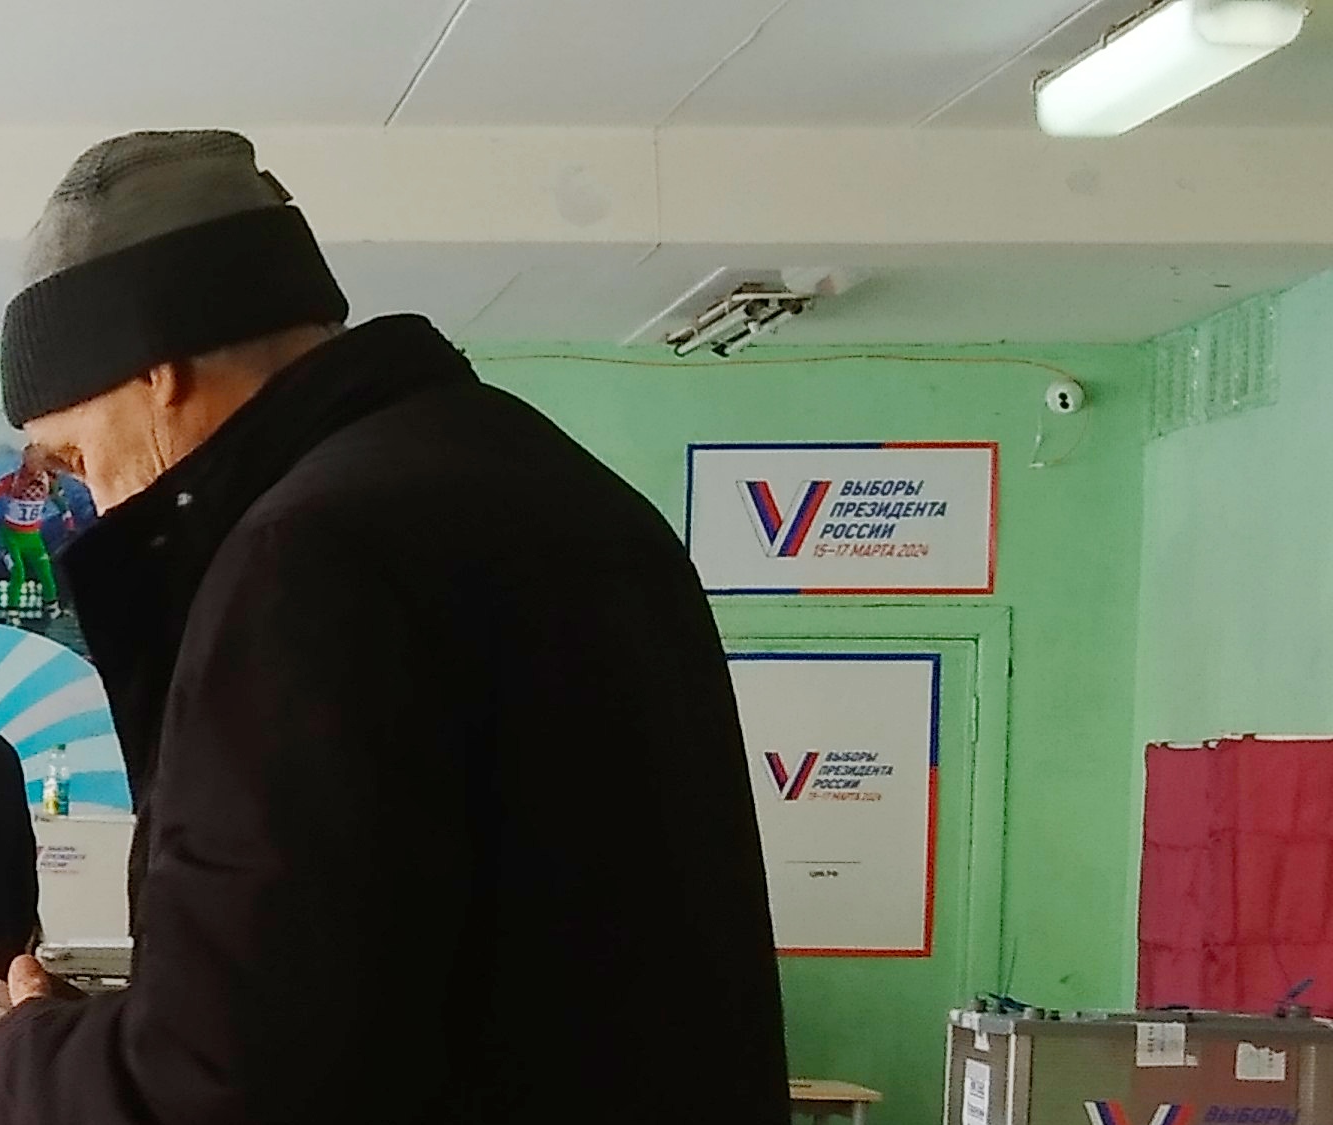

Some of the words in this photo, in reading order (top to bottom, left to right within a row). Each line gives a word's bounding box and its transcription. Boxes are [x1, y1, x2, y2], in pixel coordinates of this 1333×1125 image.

[840, 480, 924, 496] ВЫБОРЫ
[829, 502, 947, 519] ПРЕЗИДЕНТА
[819, 523, 896, 539] РОССИИ
[850, 544, 894, 557] МАРТА
[897, 544, 929, 557] 2024
[818, 765, 893, 776] ПРЕЗИДЕНТА
[812, 779, 861, 789] РОССИИ
[1204, 1105, 1299, 1124] ВЫБОРЫ
